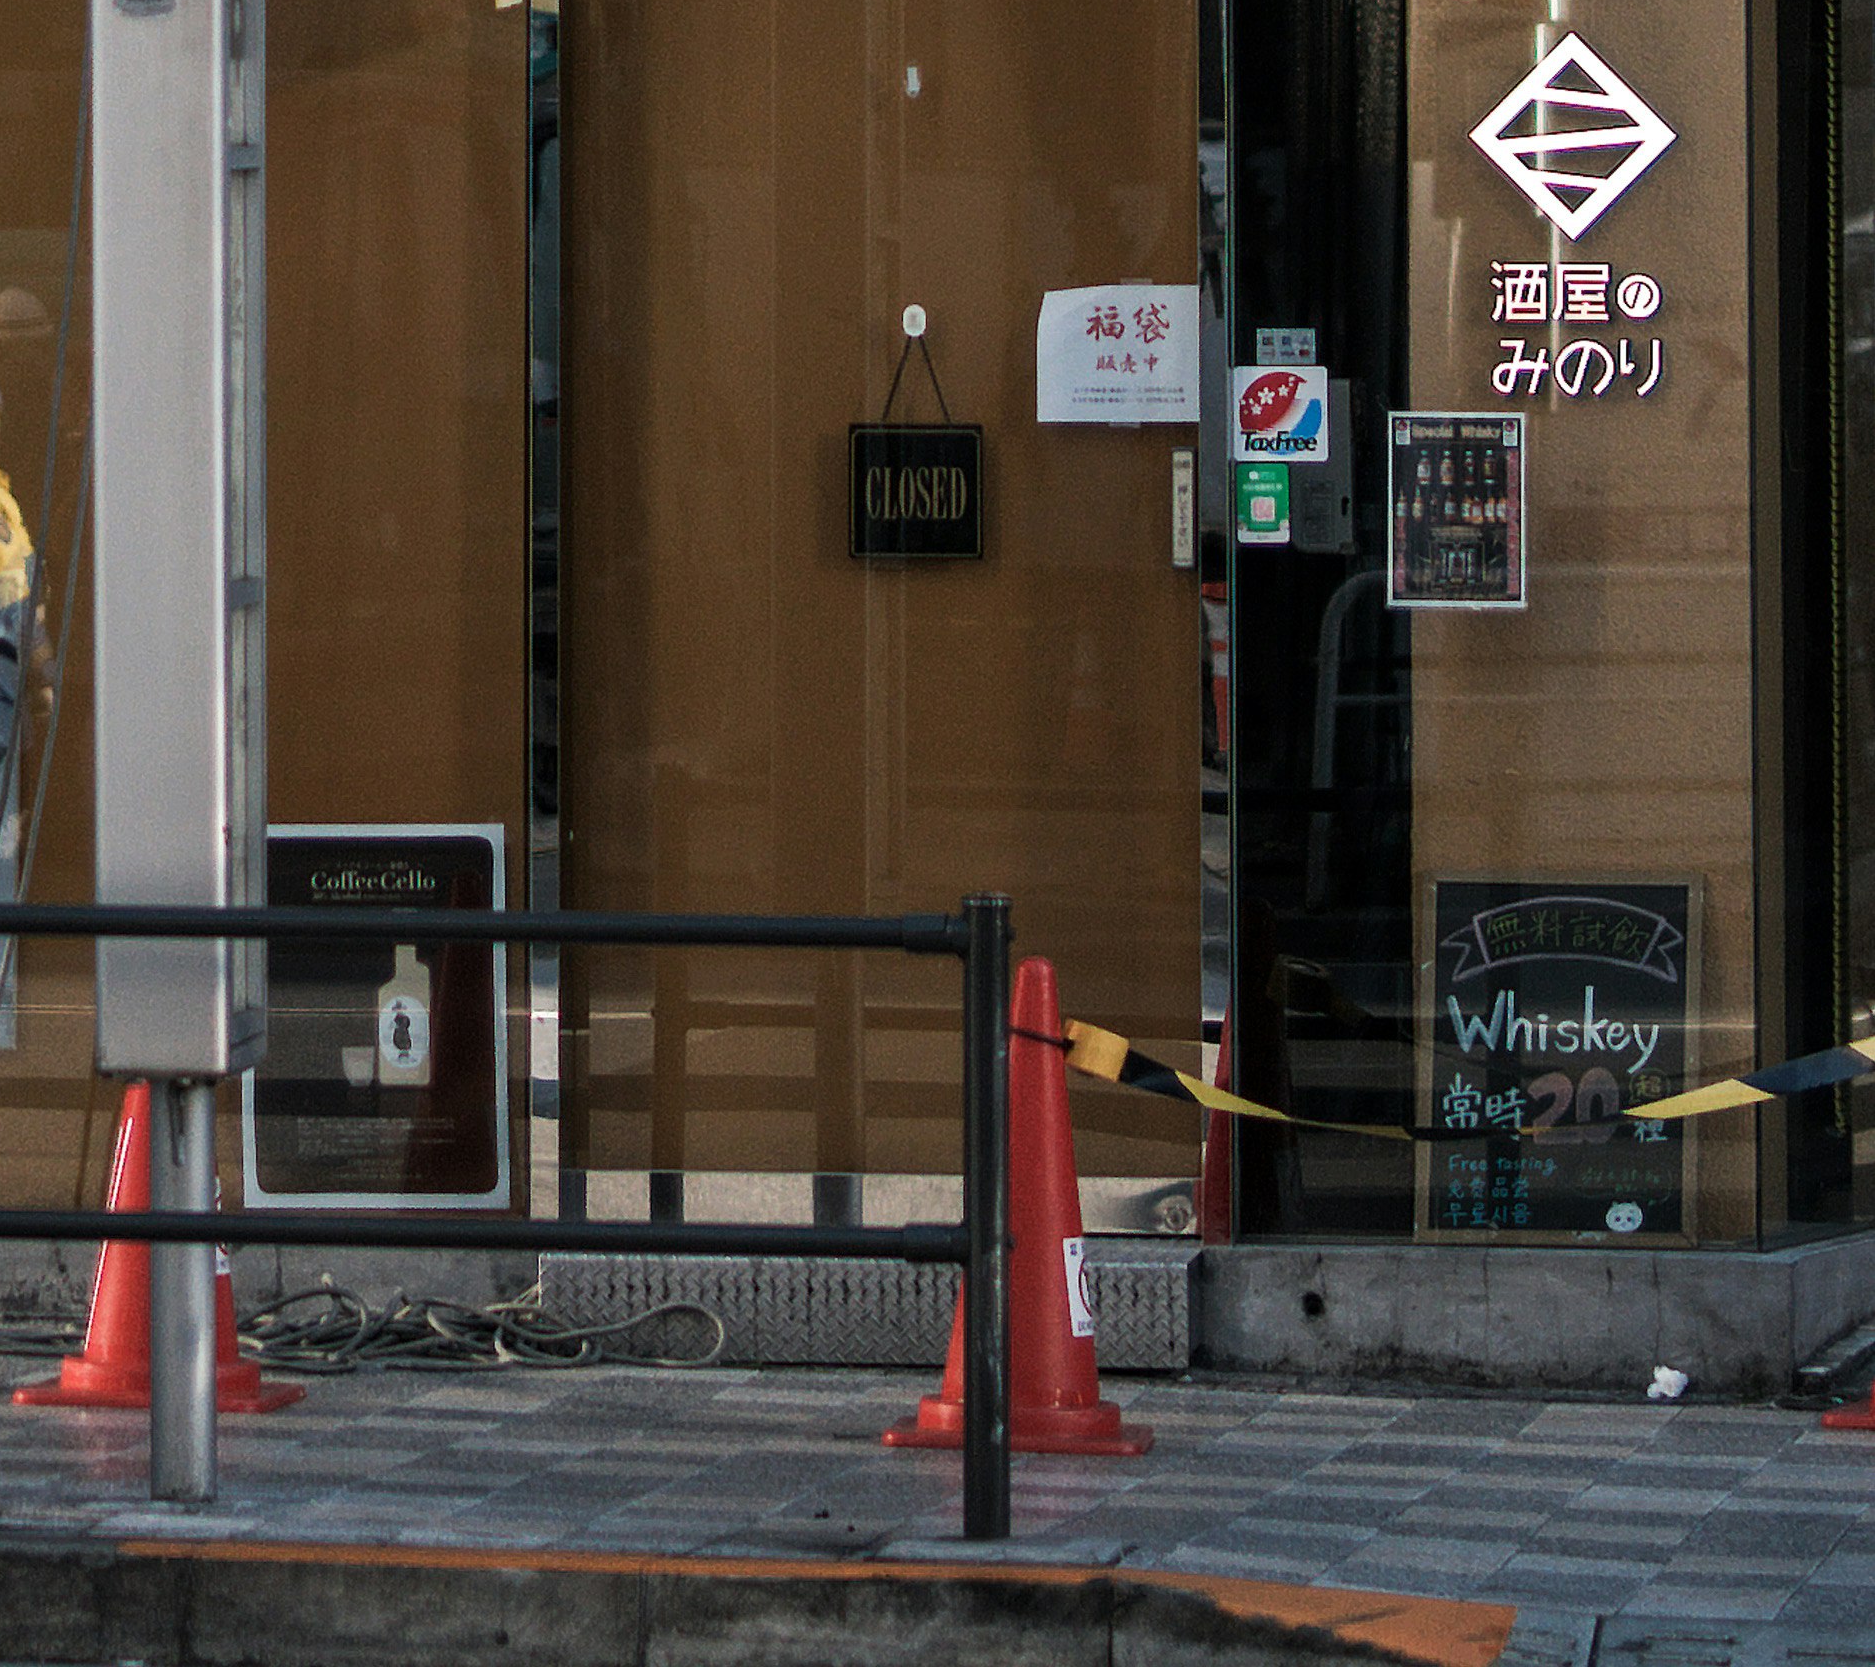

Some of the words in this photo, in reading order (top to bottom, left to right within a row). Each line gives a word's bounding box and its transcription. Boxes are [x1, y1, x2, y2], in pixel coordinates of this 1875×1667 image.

[1491, 259, 1662, 323] 酒屋の
[1085, 302, 1171, 344] 福袋
[1491, 338, 1662, 398] みのり
[865, 466, 967, 519] CLOSED
[1485, 907, 1652, 958] 無料試飲
[1446, 984, 1660, 1075] Whiskey
[1527, 1066, 1621, 1146] 20
[1448, 1153, 1488, 1173] Free
